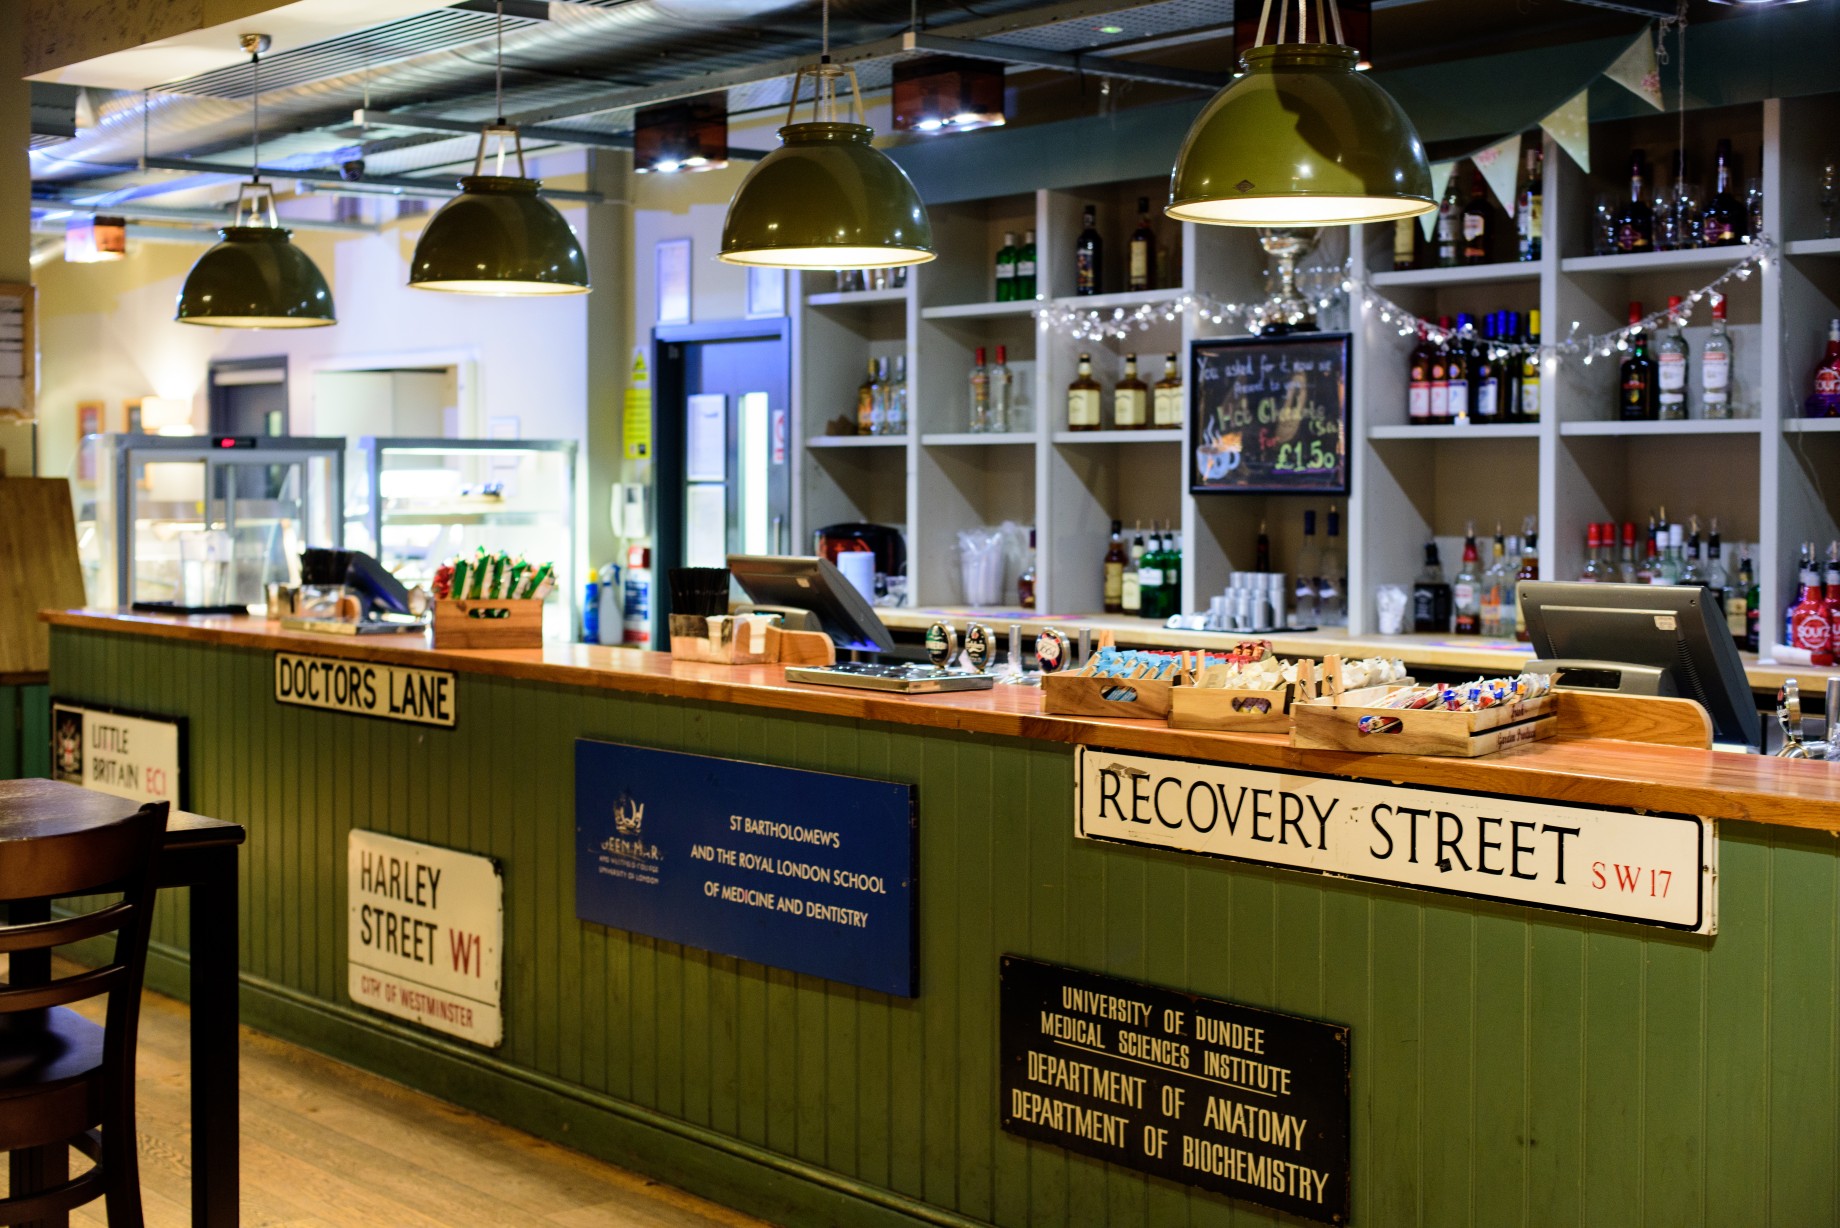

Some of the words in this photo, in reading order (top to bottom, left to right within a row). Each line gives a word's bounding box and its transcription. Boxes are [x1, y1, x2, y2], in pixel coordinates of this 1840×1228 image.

[1197, 357, 1218, 382] You
[1225, 355, 1253, 377] asked
[1260, 354, 1274, 383] for
[1293, 361, 1314, 371] now
[1217, 397, 1252, 431] Hot
[280, 658, 377, 709] DOCTORS
[389, 670, 450, 720] LANE
[92, 723, 128, 754] LITTLE
[93, 757, 139, 790] BRITAIN
[145, 767, 166, 796] EC1
[730, 815, 742, 831] ST
[745, 817, 840, 849] BARTHOLOMEW'S
[1098, 768, 1340, 851] RECOVERY
[1369, 803, 1581, 885] STREET
[361, 851, 441, 910] HARLEY
[690, 844, 714, 862] AND
[717, 848, 737, 867] THE
[739, 853, 775, 874] ROYAL
[777, 860, 831, 884] LONDON
[834, 869, 887, 895] SCHOOL
[704, 881, 720, 897] OF
[721, 885, 775, 910] MEDICINE
[777, 896, 803, 915] AND
[806, 902, 869, 928] DENTISTRY
[361, 904, 438, 965] STREET
[450, 928, 481, 979] W1
[361, 975, 381, 999] CITY
[385, 983, 397, 1003] OF
[400, 989, 473, 1028] WESTMINSTER
[1062, 985, 1152, 1028] UNIVERSITY
[1163, 1008, 1185, 1035] OF
[1196, 1015, 1264, 1055] DUNDEE
[1041, 1011, 1105, 1049] MEDICAL
[1118, 1030, 1190, 1070] SCIENCES
[1204, 1050, 1291, 1095] INSTITUTE
[1028, 1050, 1147, 1110] DEPARTMENT
[1162, 1085, 1185, 1120] OF
[1203, 1096, 1308, 1151] ANATOMY
[1012, 1088, 1129, 1149] DEPARTMENT
[1144, 1125, 1168, 1160] OF
[1183, 1135, 1329, 1205] BIOCHEMISTRY
